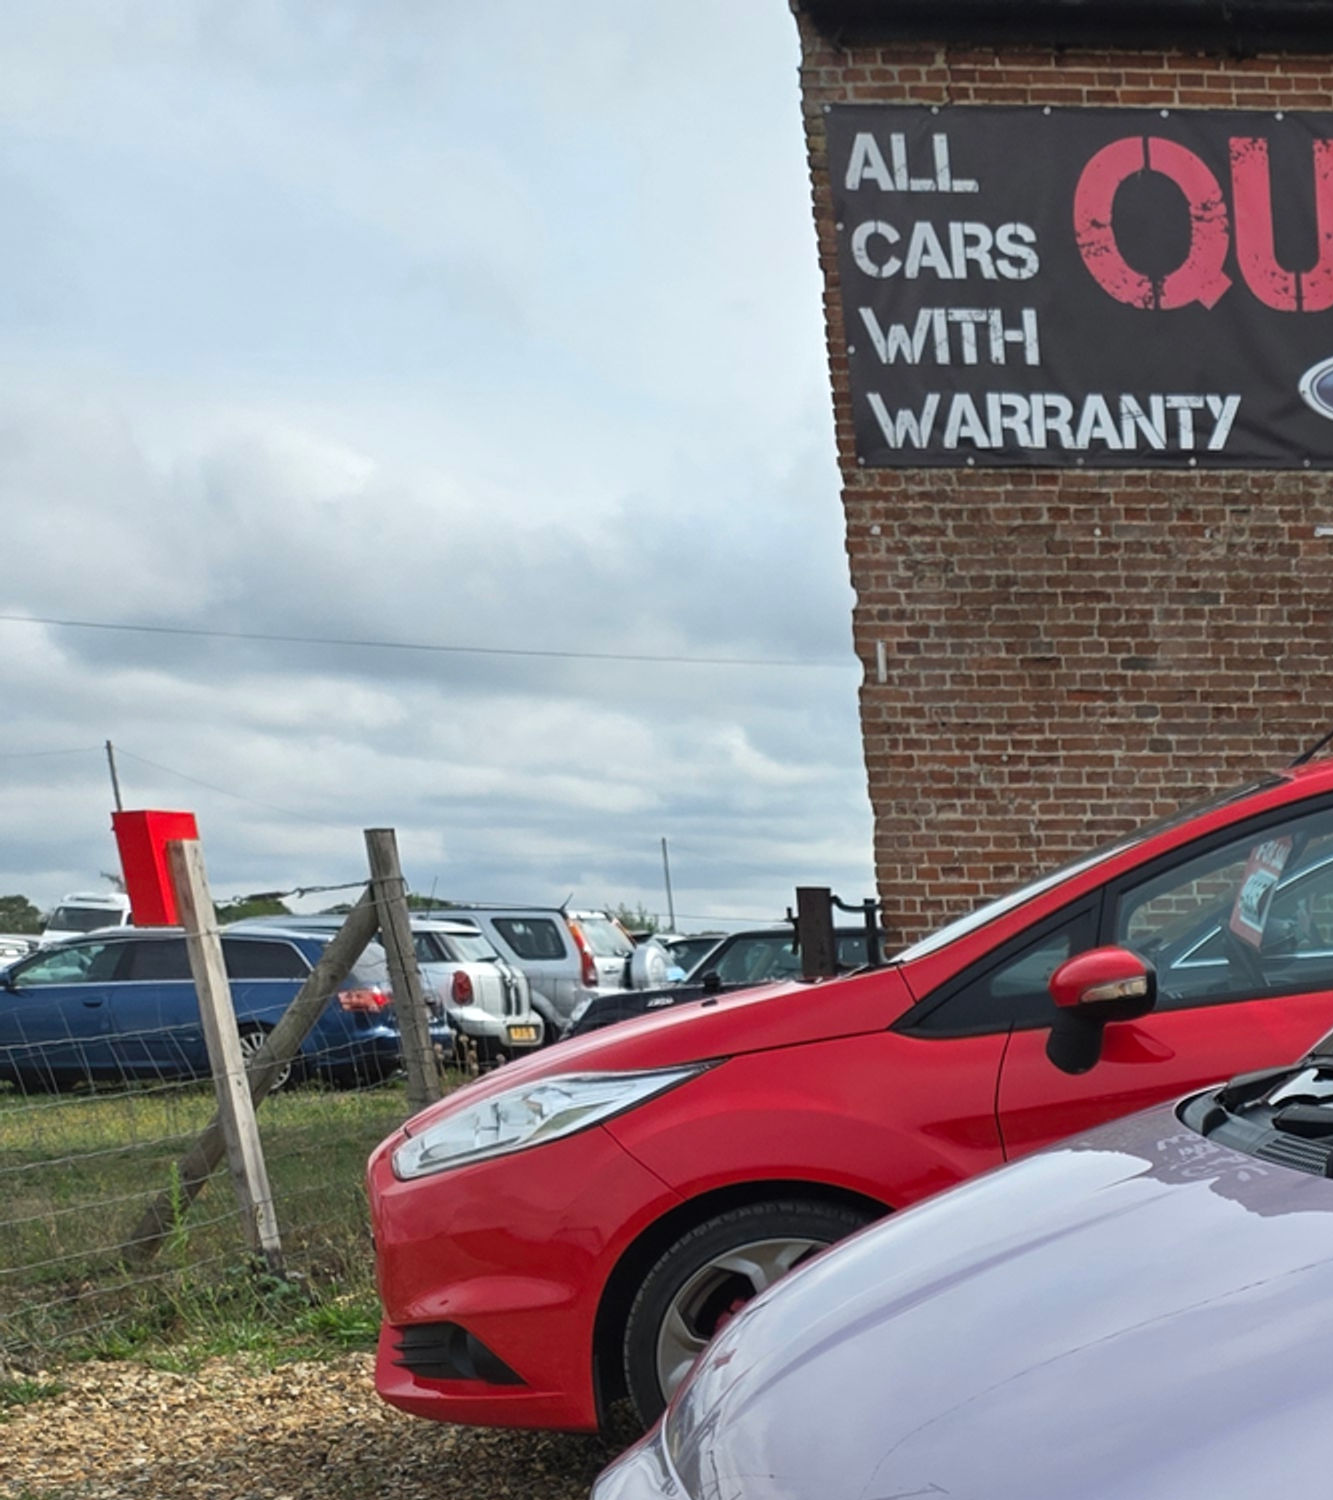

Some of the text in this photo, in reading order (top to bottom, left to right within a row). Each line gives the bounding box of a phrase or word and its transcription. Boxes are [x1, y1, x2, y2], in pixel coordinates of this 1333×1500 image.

[845, 132, 979, 193] ALL
[851, 220, 1040, 280] CARS
[858, 307, 1040, 366] WITH
[866, 392, 1242, 451] WARRANTY
